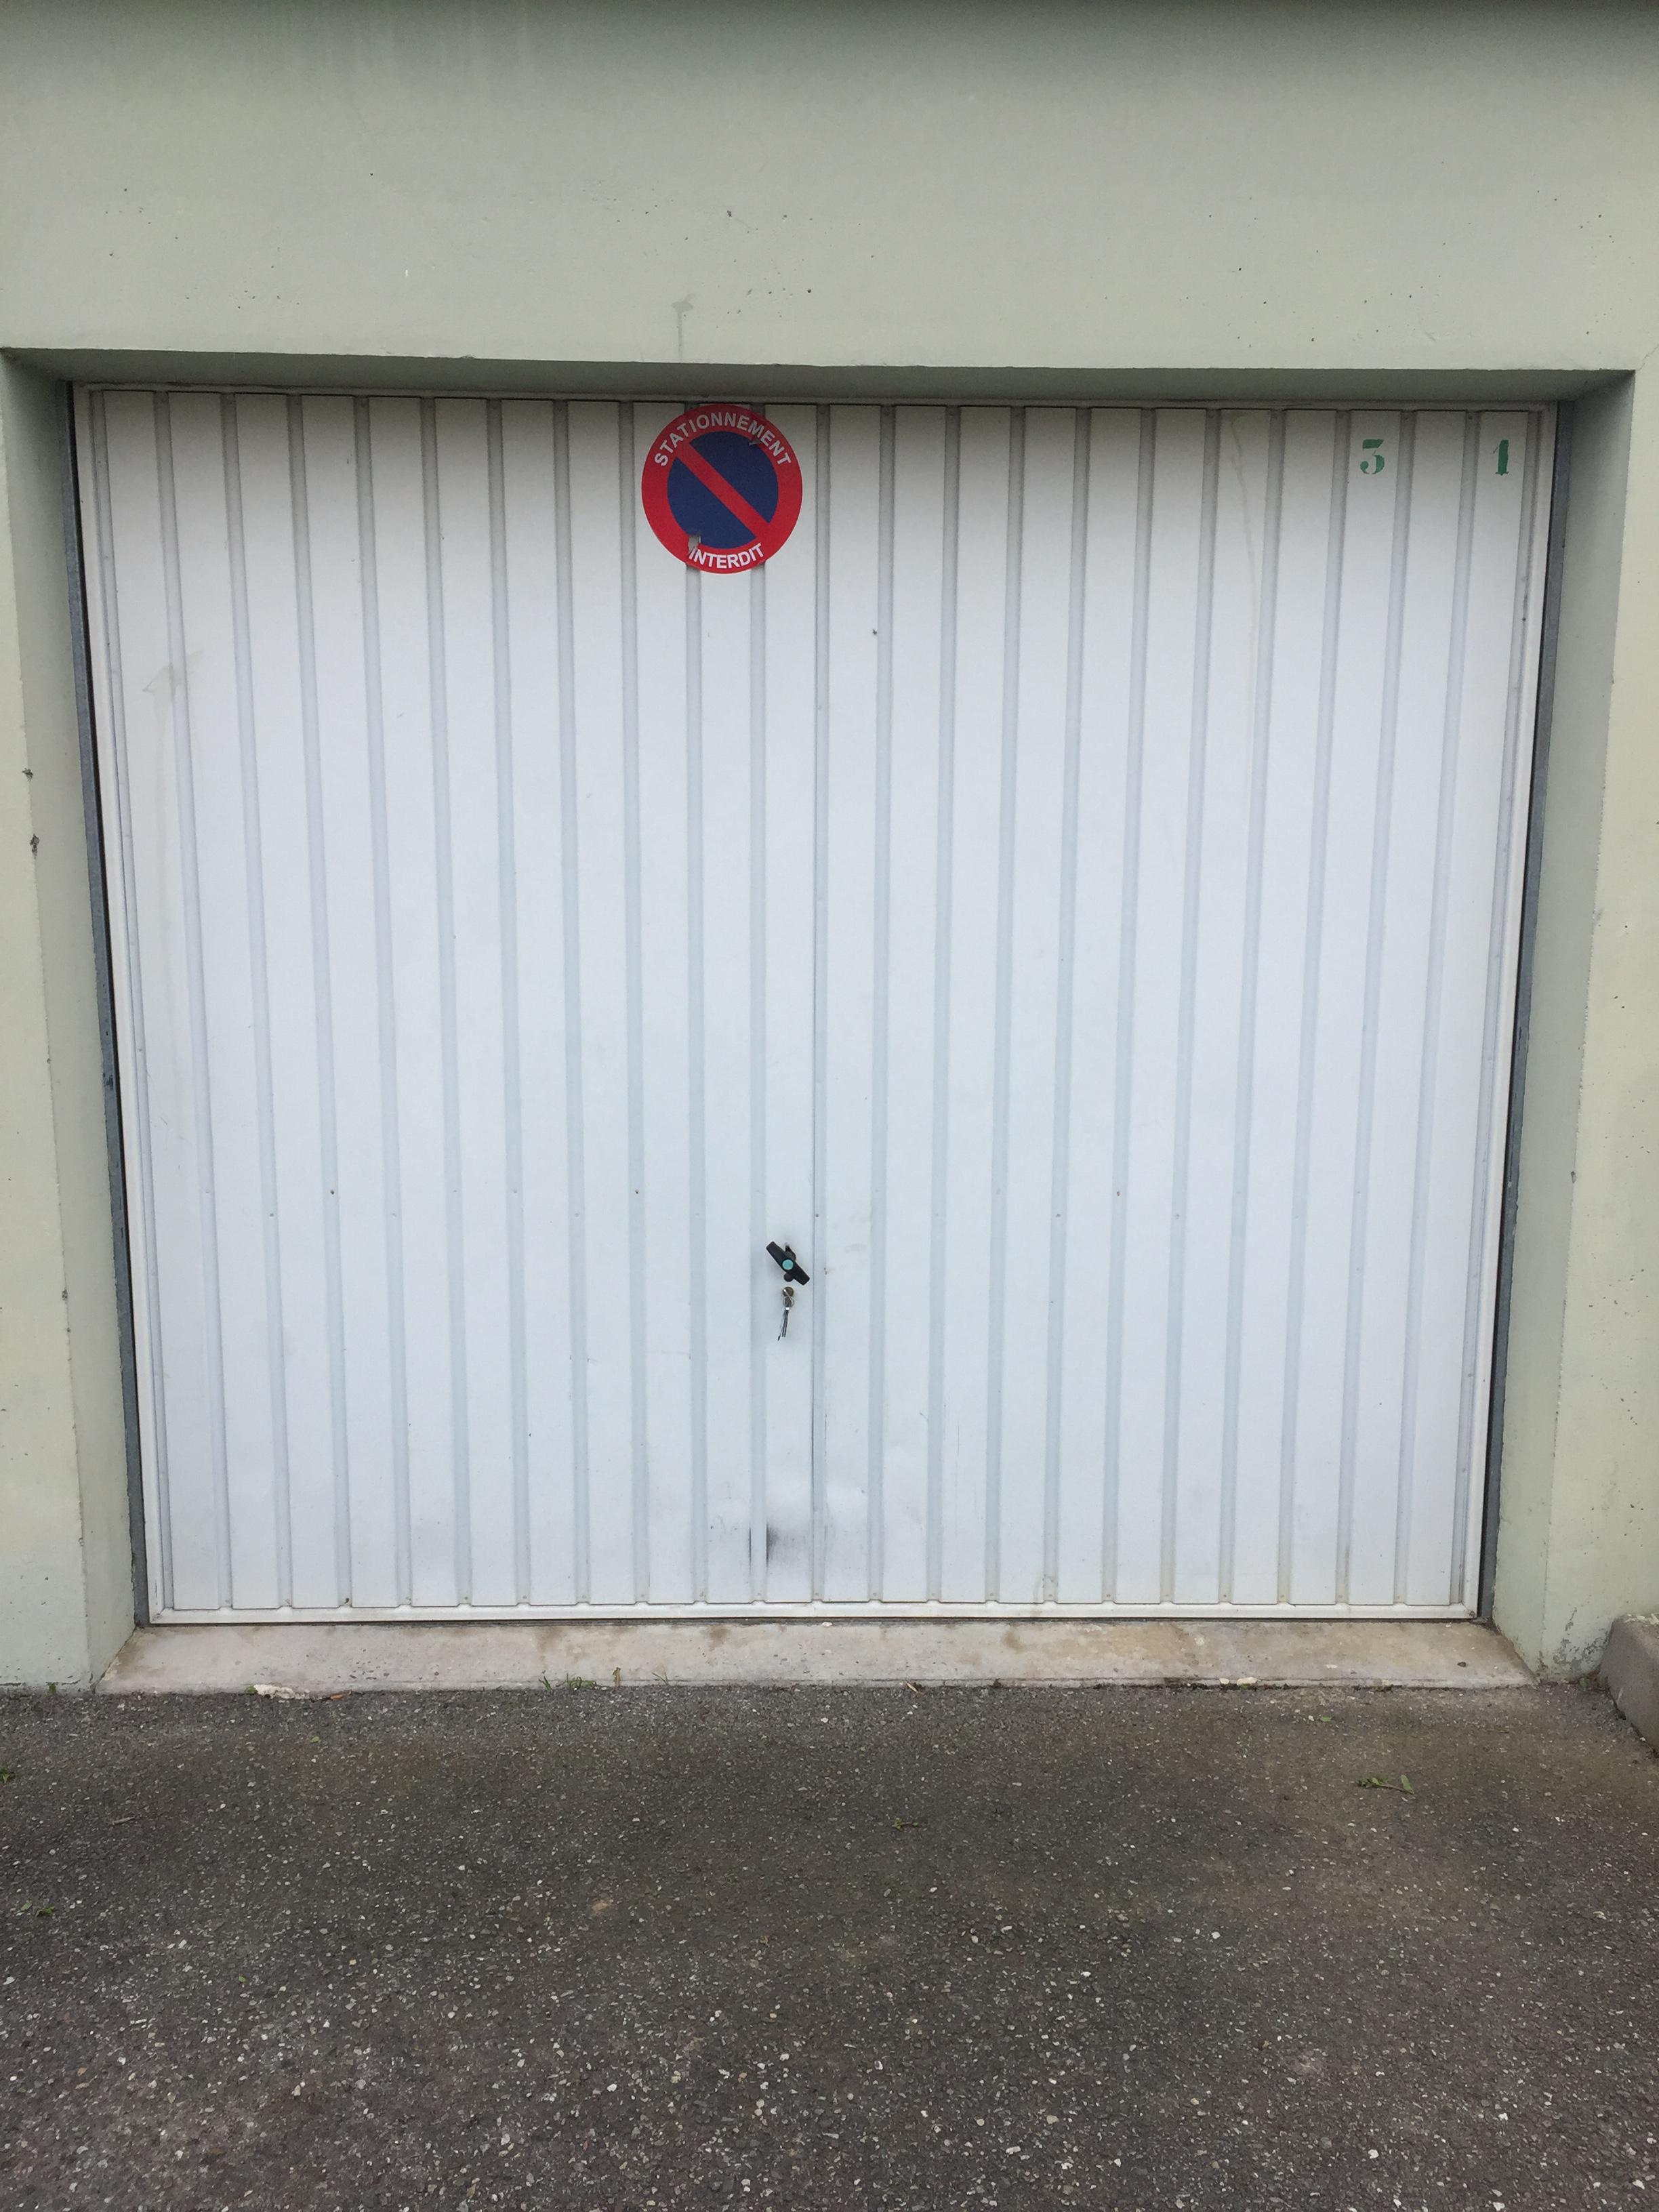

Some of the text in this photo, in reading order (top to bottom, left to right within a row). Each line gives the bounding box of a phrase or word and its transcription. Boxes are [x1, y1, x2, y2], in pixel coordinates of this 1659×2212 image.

[654, 411, 792, 467] STATIONNEMENT
[1493, 438, 1509, 476] 1
[688, 543, 765, 569] INTERDIT
